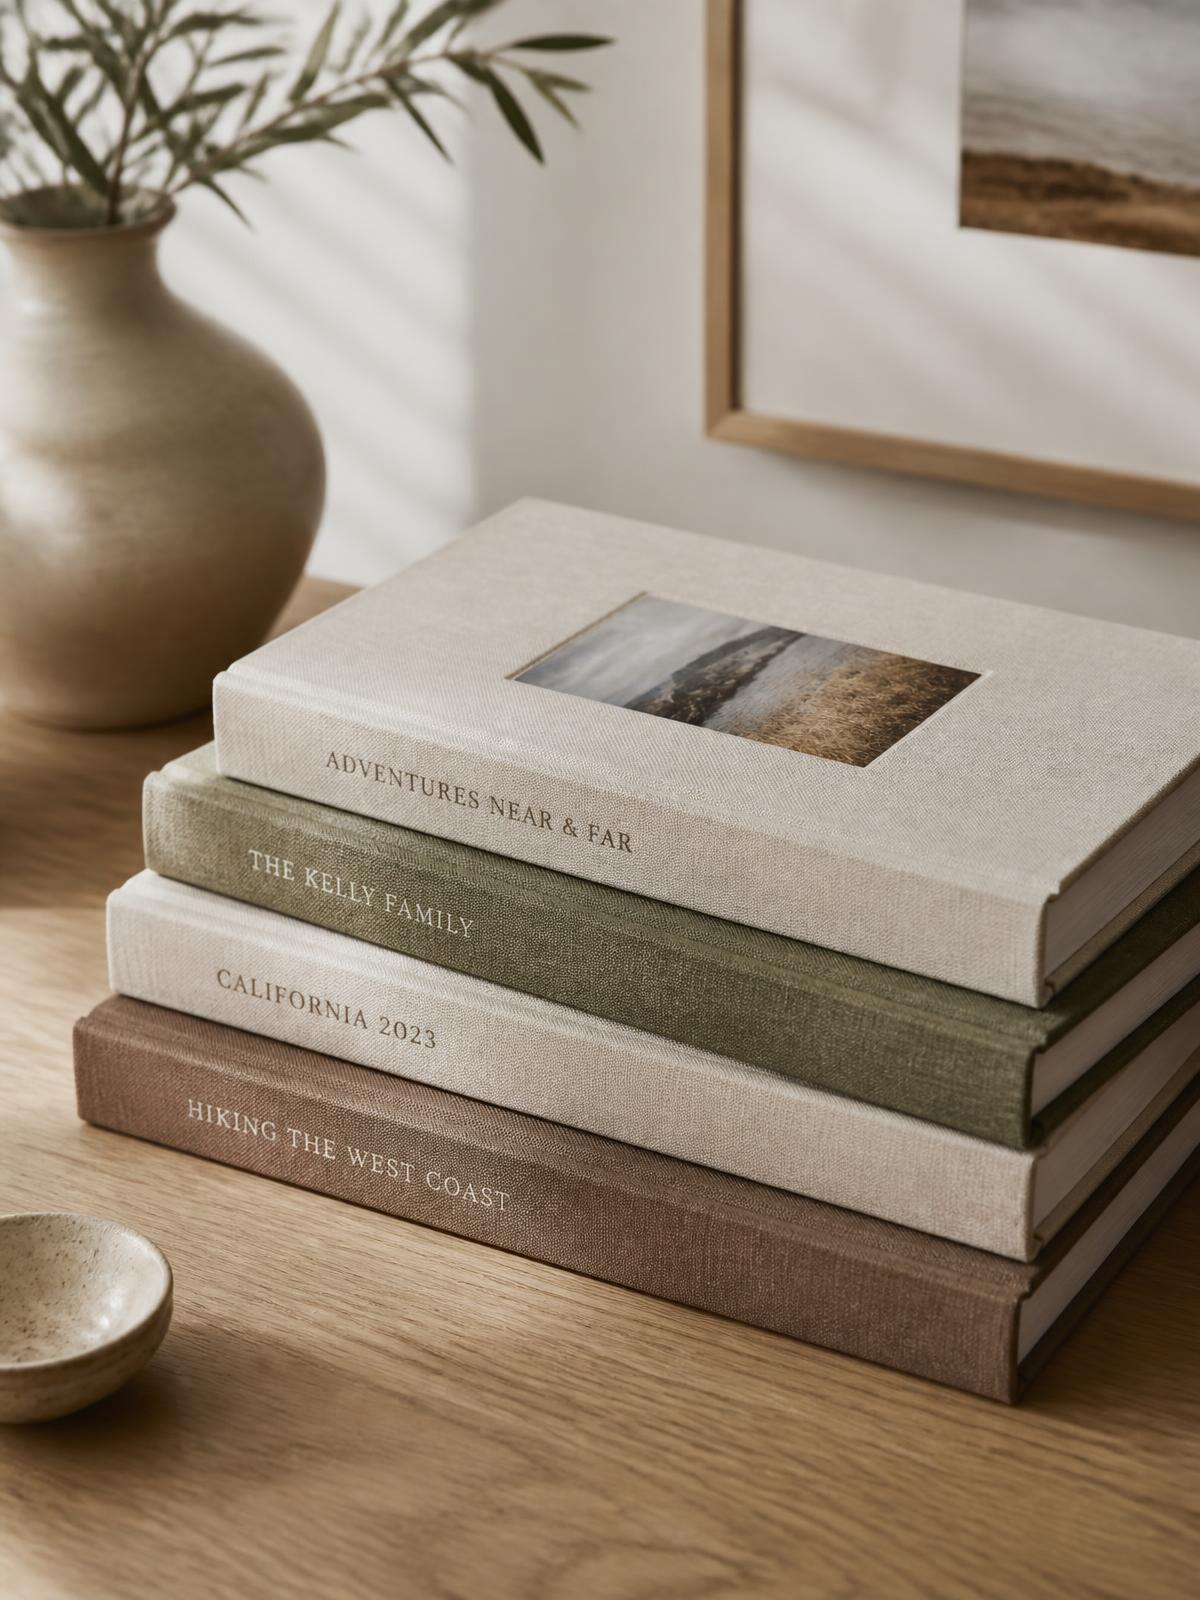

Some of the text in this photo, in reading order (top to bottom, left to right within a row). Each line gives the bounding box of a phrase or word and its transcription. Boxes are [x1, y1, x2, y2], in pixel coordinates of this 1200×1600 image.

[326, 751, 633, 853] ADVENTURES NEAR & FAR
[249, 850, 474, 938] THE KELLY FAMILY
[217, 969, 436, 1049] CALIFORNIA 2023
[188, 1099, 511, 1211] HIKING THE WEST COAST
